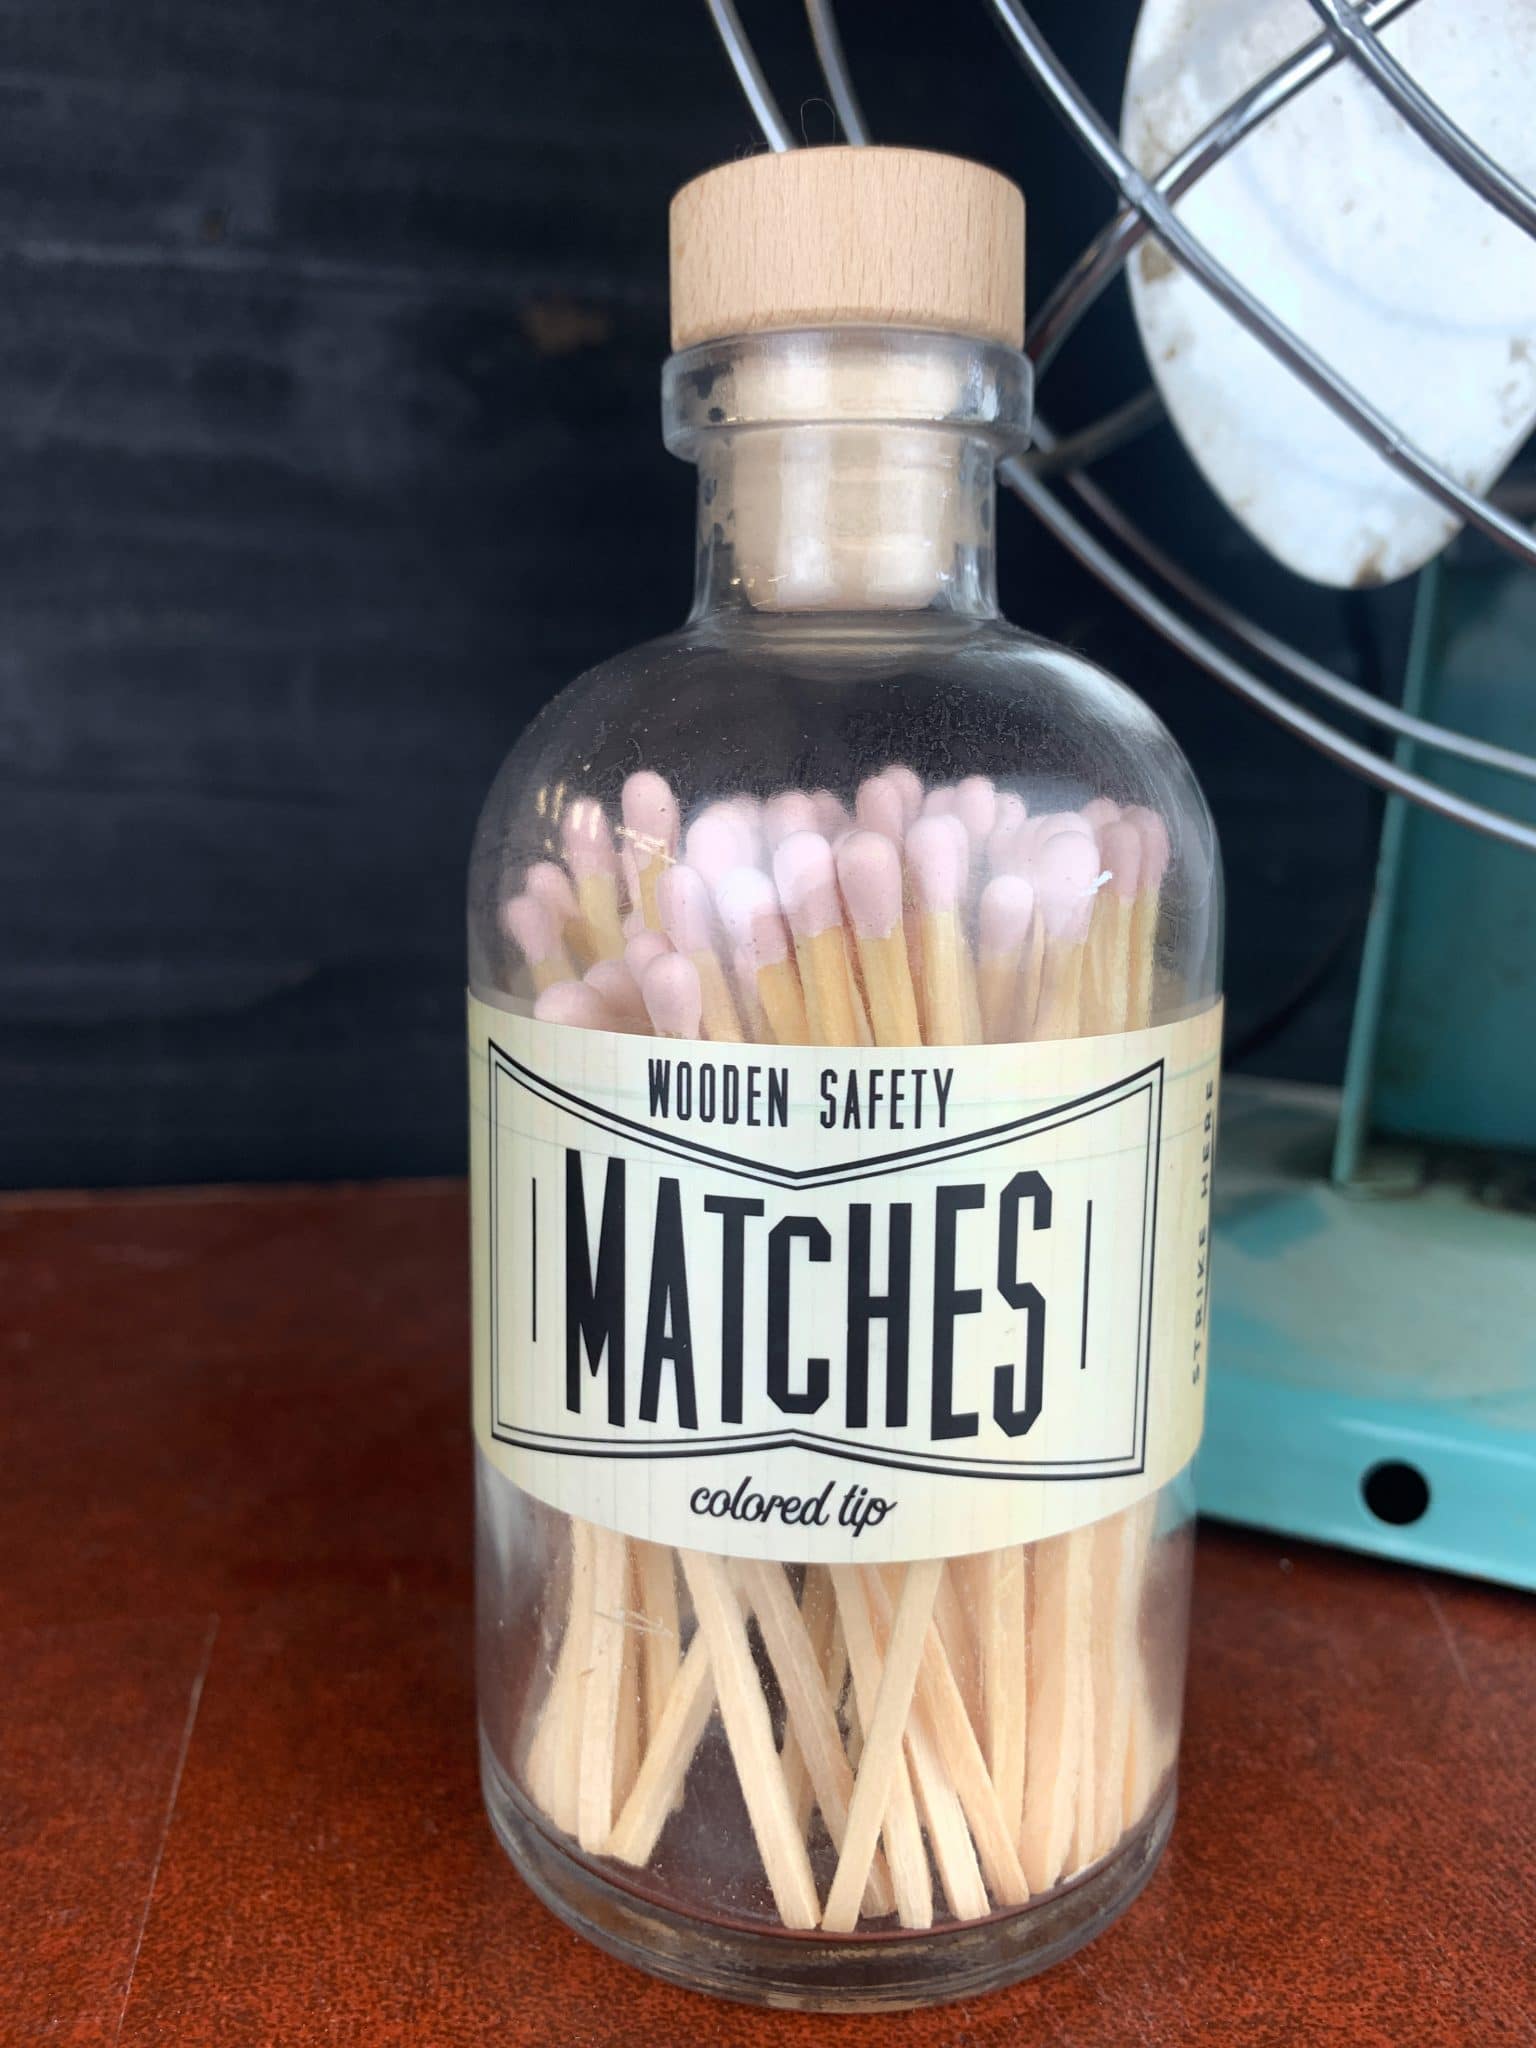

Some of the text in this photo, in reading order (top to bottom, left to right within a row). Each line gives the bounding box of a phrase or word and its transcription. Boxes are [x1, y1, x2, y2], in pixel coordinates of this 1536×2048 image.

[648, 1058, 955, 1130] WOODEN SAFETY
[565, 1147, 1053, 1441] MATCHES
[1192, 1079, 1213, 1385] STRIKE HERE
[689, 1476, 898, 1537] colored tip
